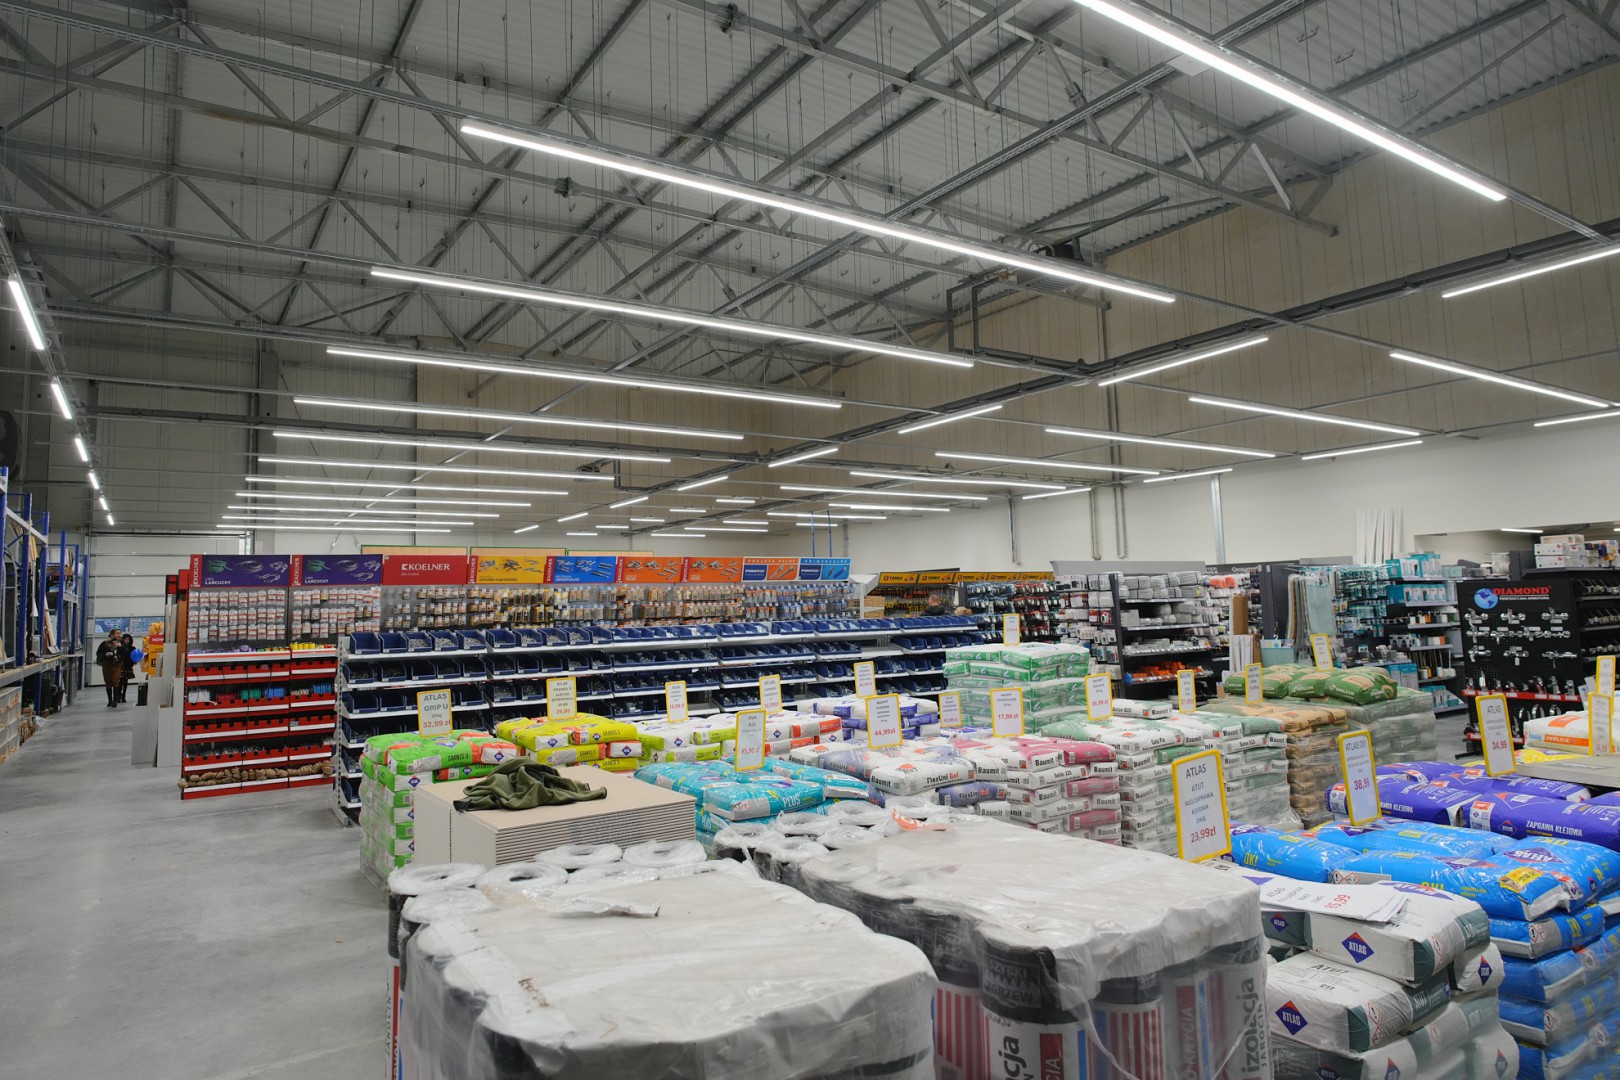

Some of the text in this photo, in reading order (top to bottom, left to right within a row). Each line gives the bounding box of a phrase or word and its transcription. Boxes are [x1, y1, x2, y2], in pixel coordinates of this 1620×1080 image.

[1493, 586, 1549, 595] DIAMOND
[424, 693, 447, 701] ATLAS
[1035, 758, 1054, 766] Baumit
[1134, 757, 1151, 768] Baumit
[1186, 764, 1206, 779] ATLAS
[871, 776, 891, 788] Baumit
[927, 774, 948, 784] FlexUni
[1191, 782, 1204, 792] ATUT
[783, 795, 800, 808] PLUS
[1039, 792, 1057, 800] Baumit
[1191, 826, 1216, 842] 23,99zł
[1526, 820, 1554, 833] ZAPRAWA
[1555, 826, 1583, 837] KLEJOWA
[1244, 852, 1259, 866] OK!
[1349, 941, 1367, 955] ATLAS
[989, 960, 1028, 977] SZYBKI
[1236, 978, 1260, 1072] izolacja
[1283, 1011, 1300, 1026] ATLAS
